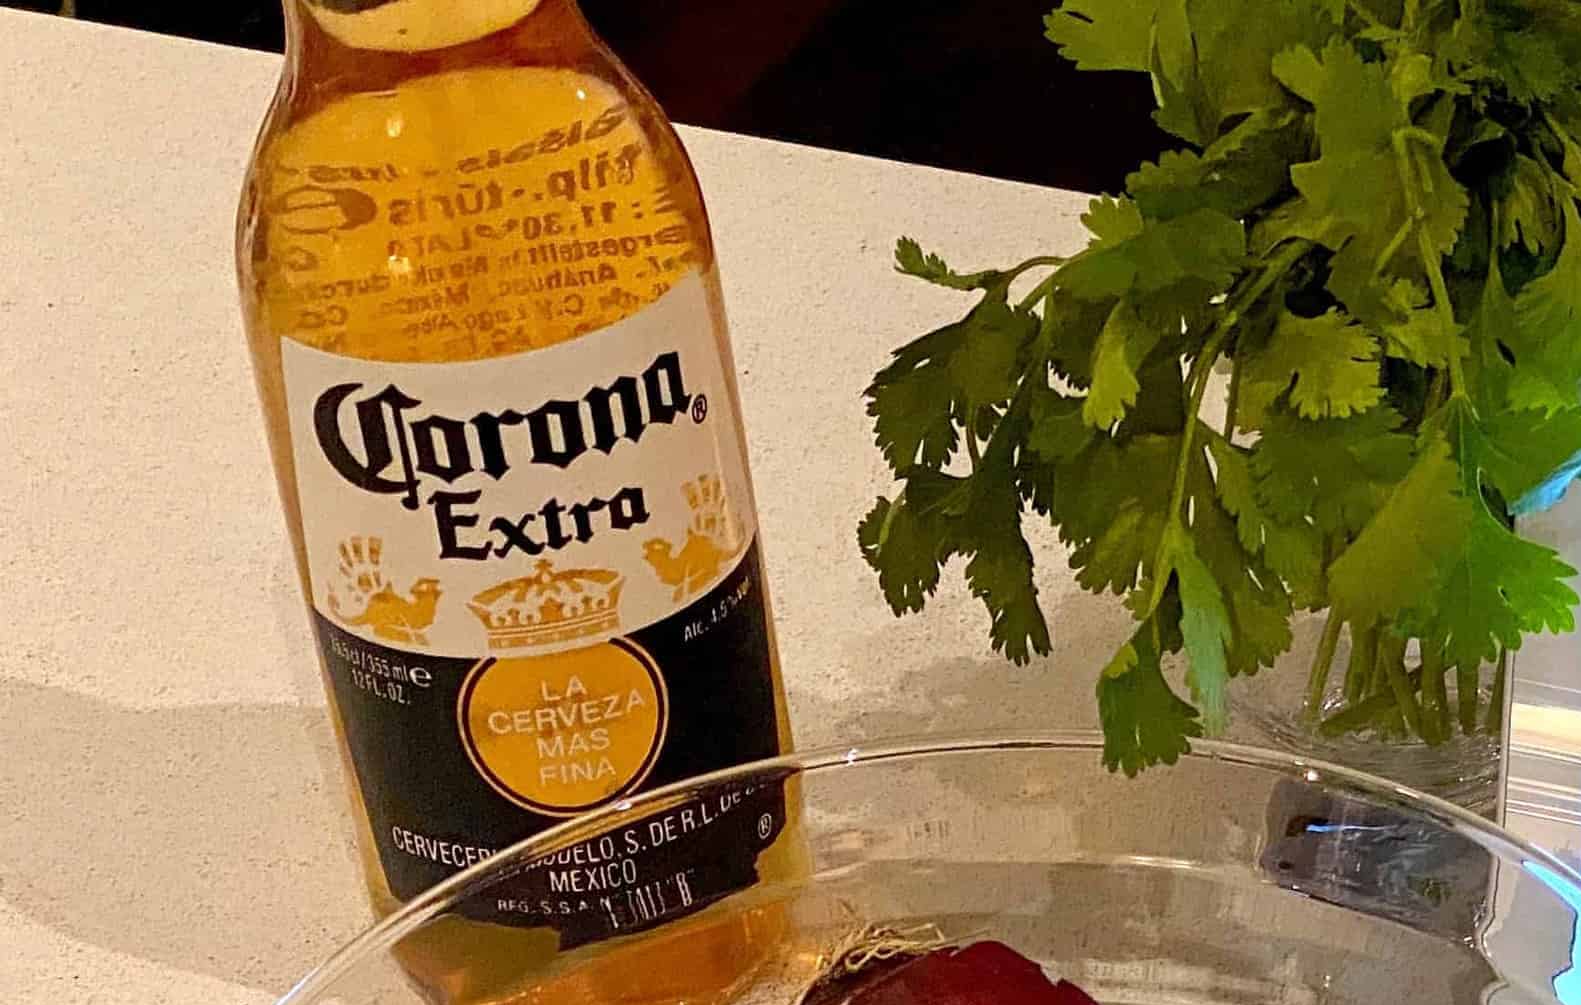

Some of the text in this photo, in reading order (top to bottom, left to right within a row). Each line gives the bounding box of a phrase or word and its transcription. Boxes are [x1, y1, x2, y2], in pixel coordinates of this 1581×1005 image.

[313, 351, 692, 511] Corona
[427, 486, 650, 561] Extra
[541, 674, 588, 702] LA
[487, 688, 646, 735] CERVEZA
[535, 727, 611, 760] MAS
[539, 755, 618, 787] FINA
[392, 826, 498, 868] CERVECER
[649, 816, 678, 847] DE
[550, 858, 637, 892] MEXICO
